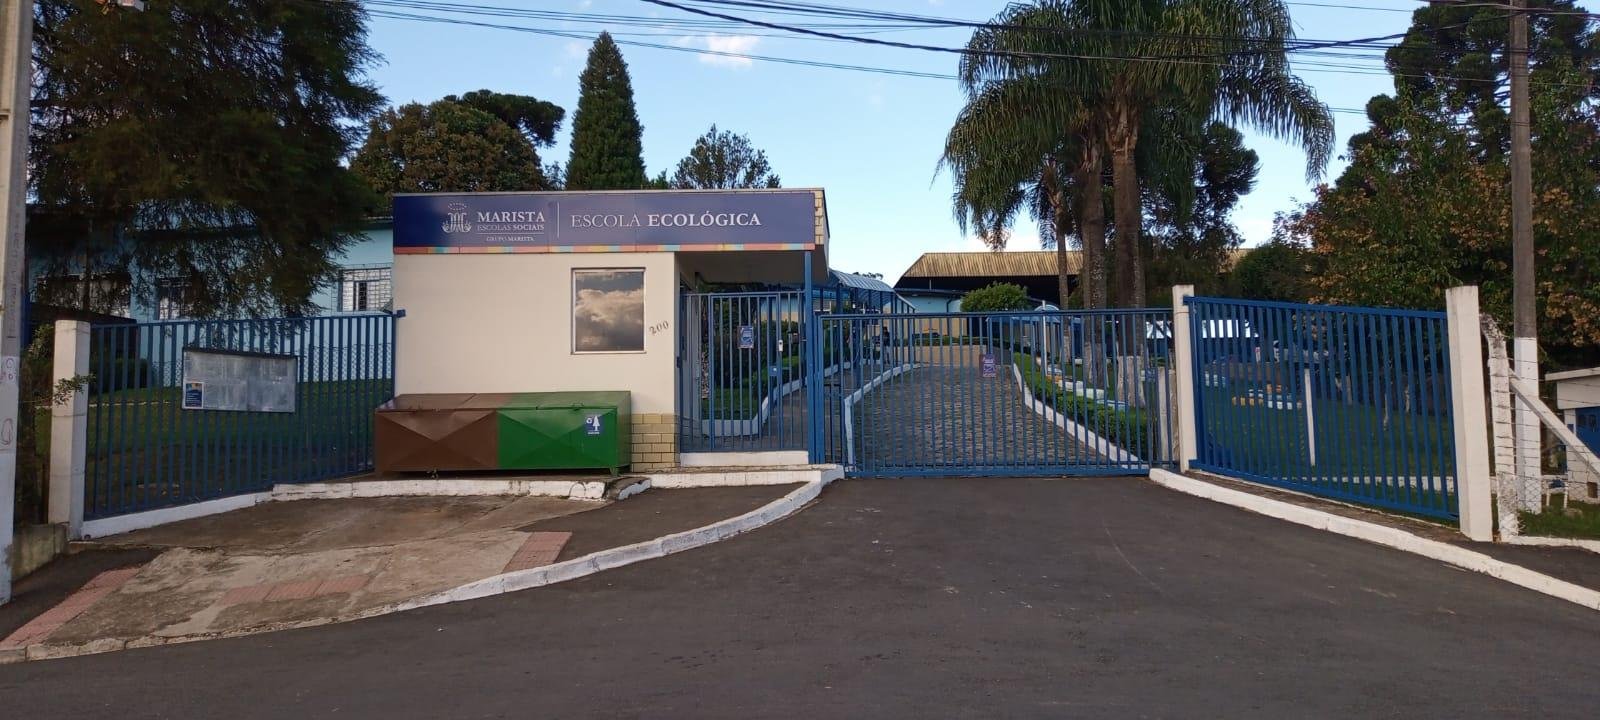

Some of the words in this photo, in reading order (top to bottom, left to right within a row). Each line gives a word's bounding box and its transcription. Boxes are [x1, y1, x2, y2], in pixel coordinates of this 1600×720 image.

[477, 211, 546, 223] MARISTA
[571, 214, 641, 228] ESCOLA
[647, 210, 762, 227] ECOLÓGICA
[477, 224, 512, 232] ESCOLAS
[649, 320, 669, 335] 200
